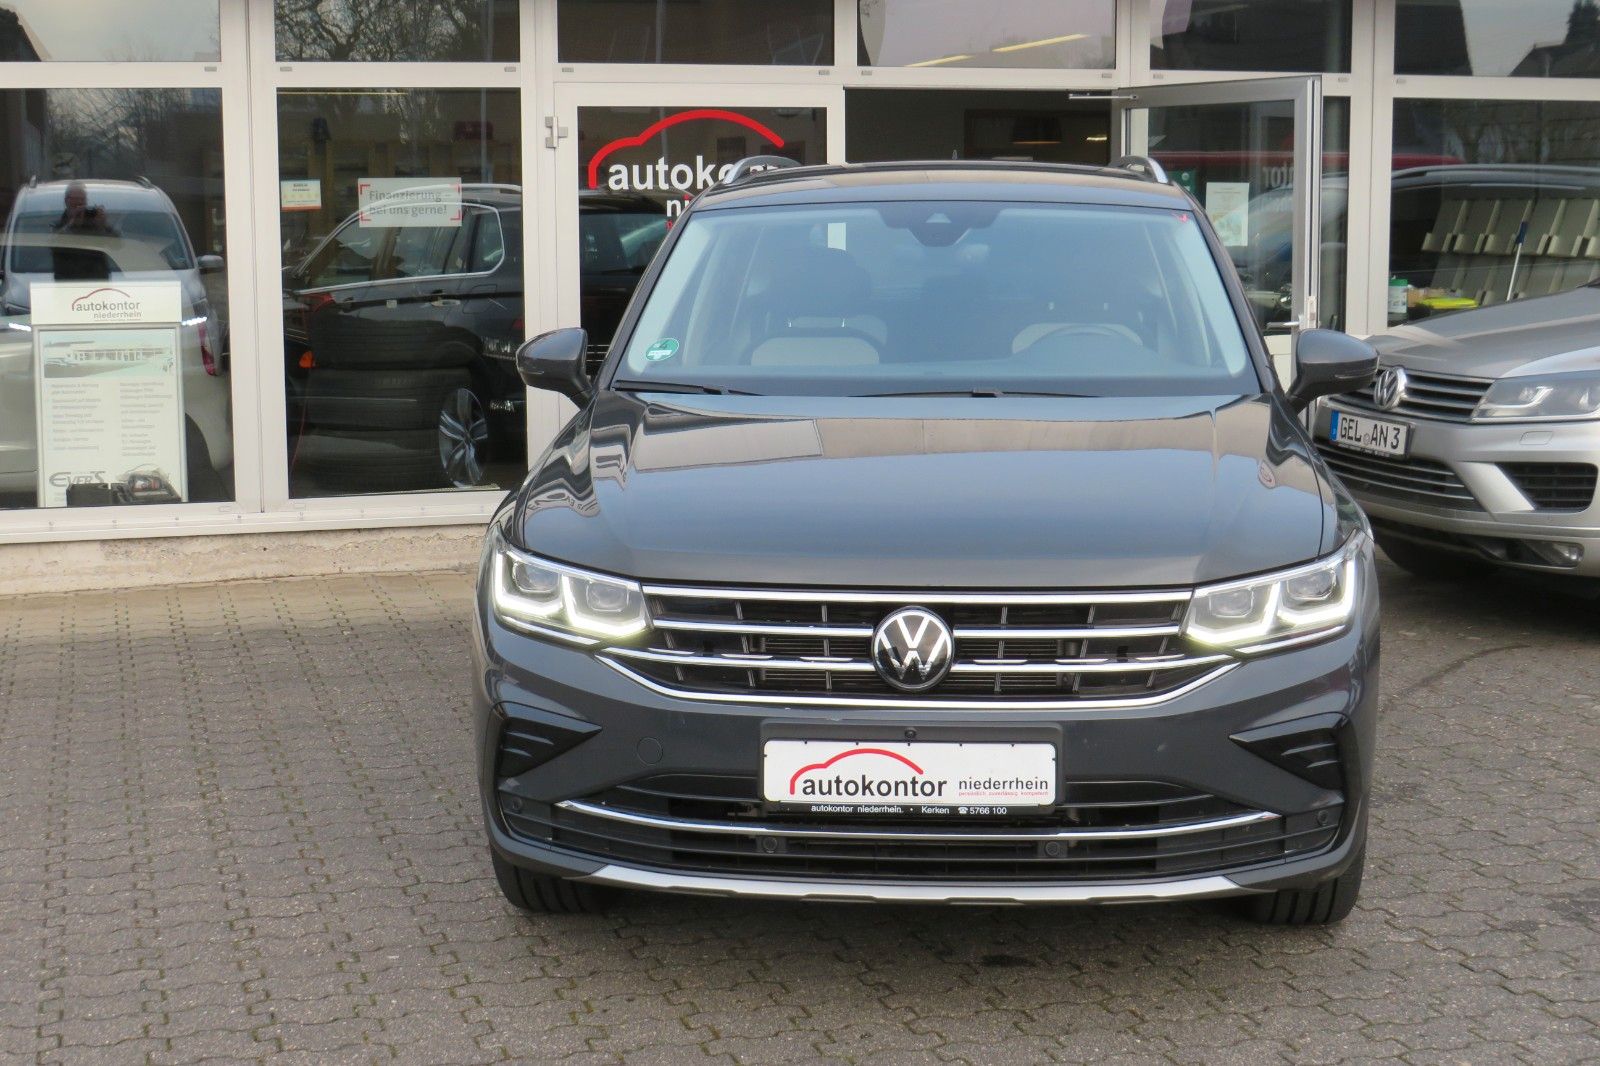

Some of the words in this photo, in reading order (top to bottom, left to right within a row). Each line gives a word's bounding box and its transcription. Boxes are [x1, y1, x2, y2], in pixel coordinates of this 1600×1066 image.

[369, 190, 441, 203] Finanzierung
[369, 205, 386, 215] bei
[390, 206, 410, 215] uns
[411, 205, 448, 218] gerne!
[76, 300, 141, 312] autokontor
[93, 310, 142, 319] niederrhein
[1340, 417, 1362, 442] GEL
[1370, 423, 1389, 447] AN
[1390, 426, 1401, 450] 3
[802, 774, 948, 797] autokontor
[958, 776, 1049, 790] niederrhein
[810, 804, 854, 813] autokontor
[921, 805, 950, 815] Kerken
[969, 806, 990, 815] 5766
[992, 806, 1008, 815] 100
